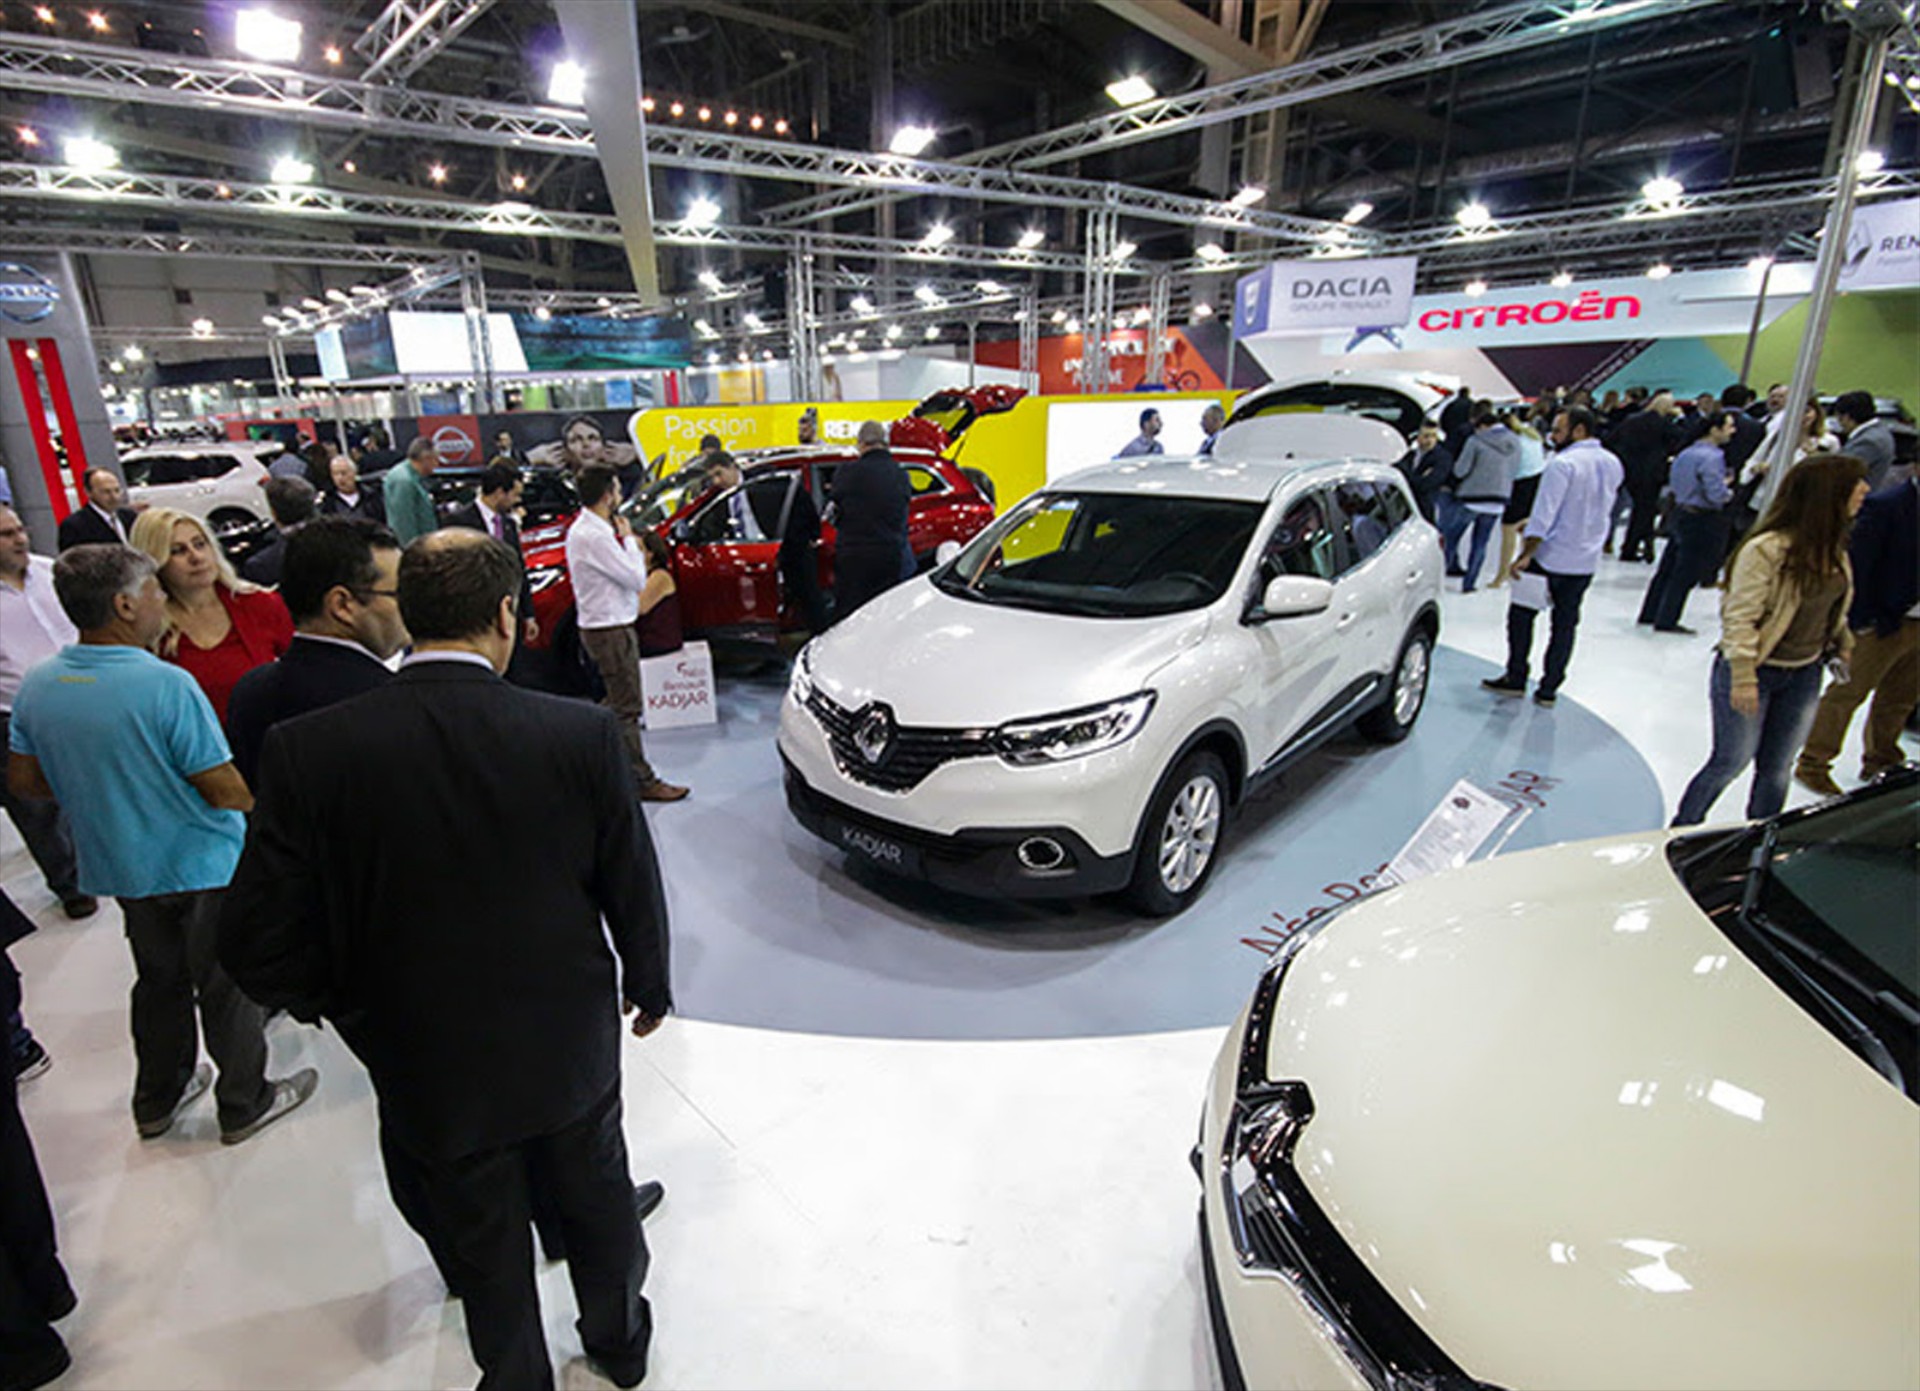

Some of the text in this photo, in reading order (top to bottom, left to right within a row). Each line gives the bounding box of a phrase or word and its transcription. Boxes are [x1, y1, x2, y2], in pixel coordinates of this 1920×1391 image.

[1292, 276, 1391, 299] DACIA
[1418, 290, 1641, 332] CITROËN
[664, 413, 757, 439] Passion
[648, 691, 708, 710] KADJAR
